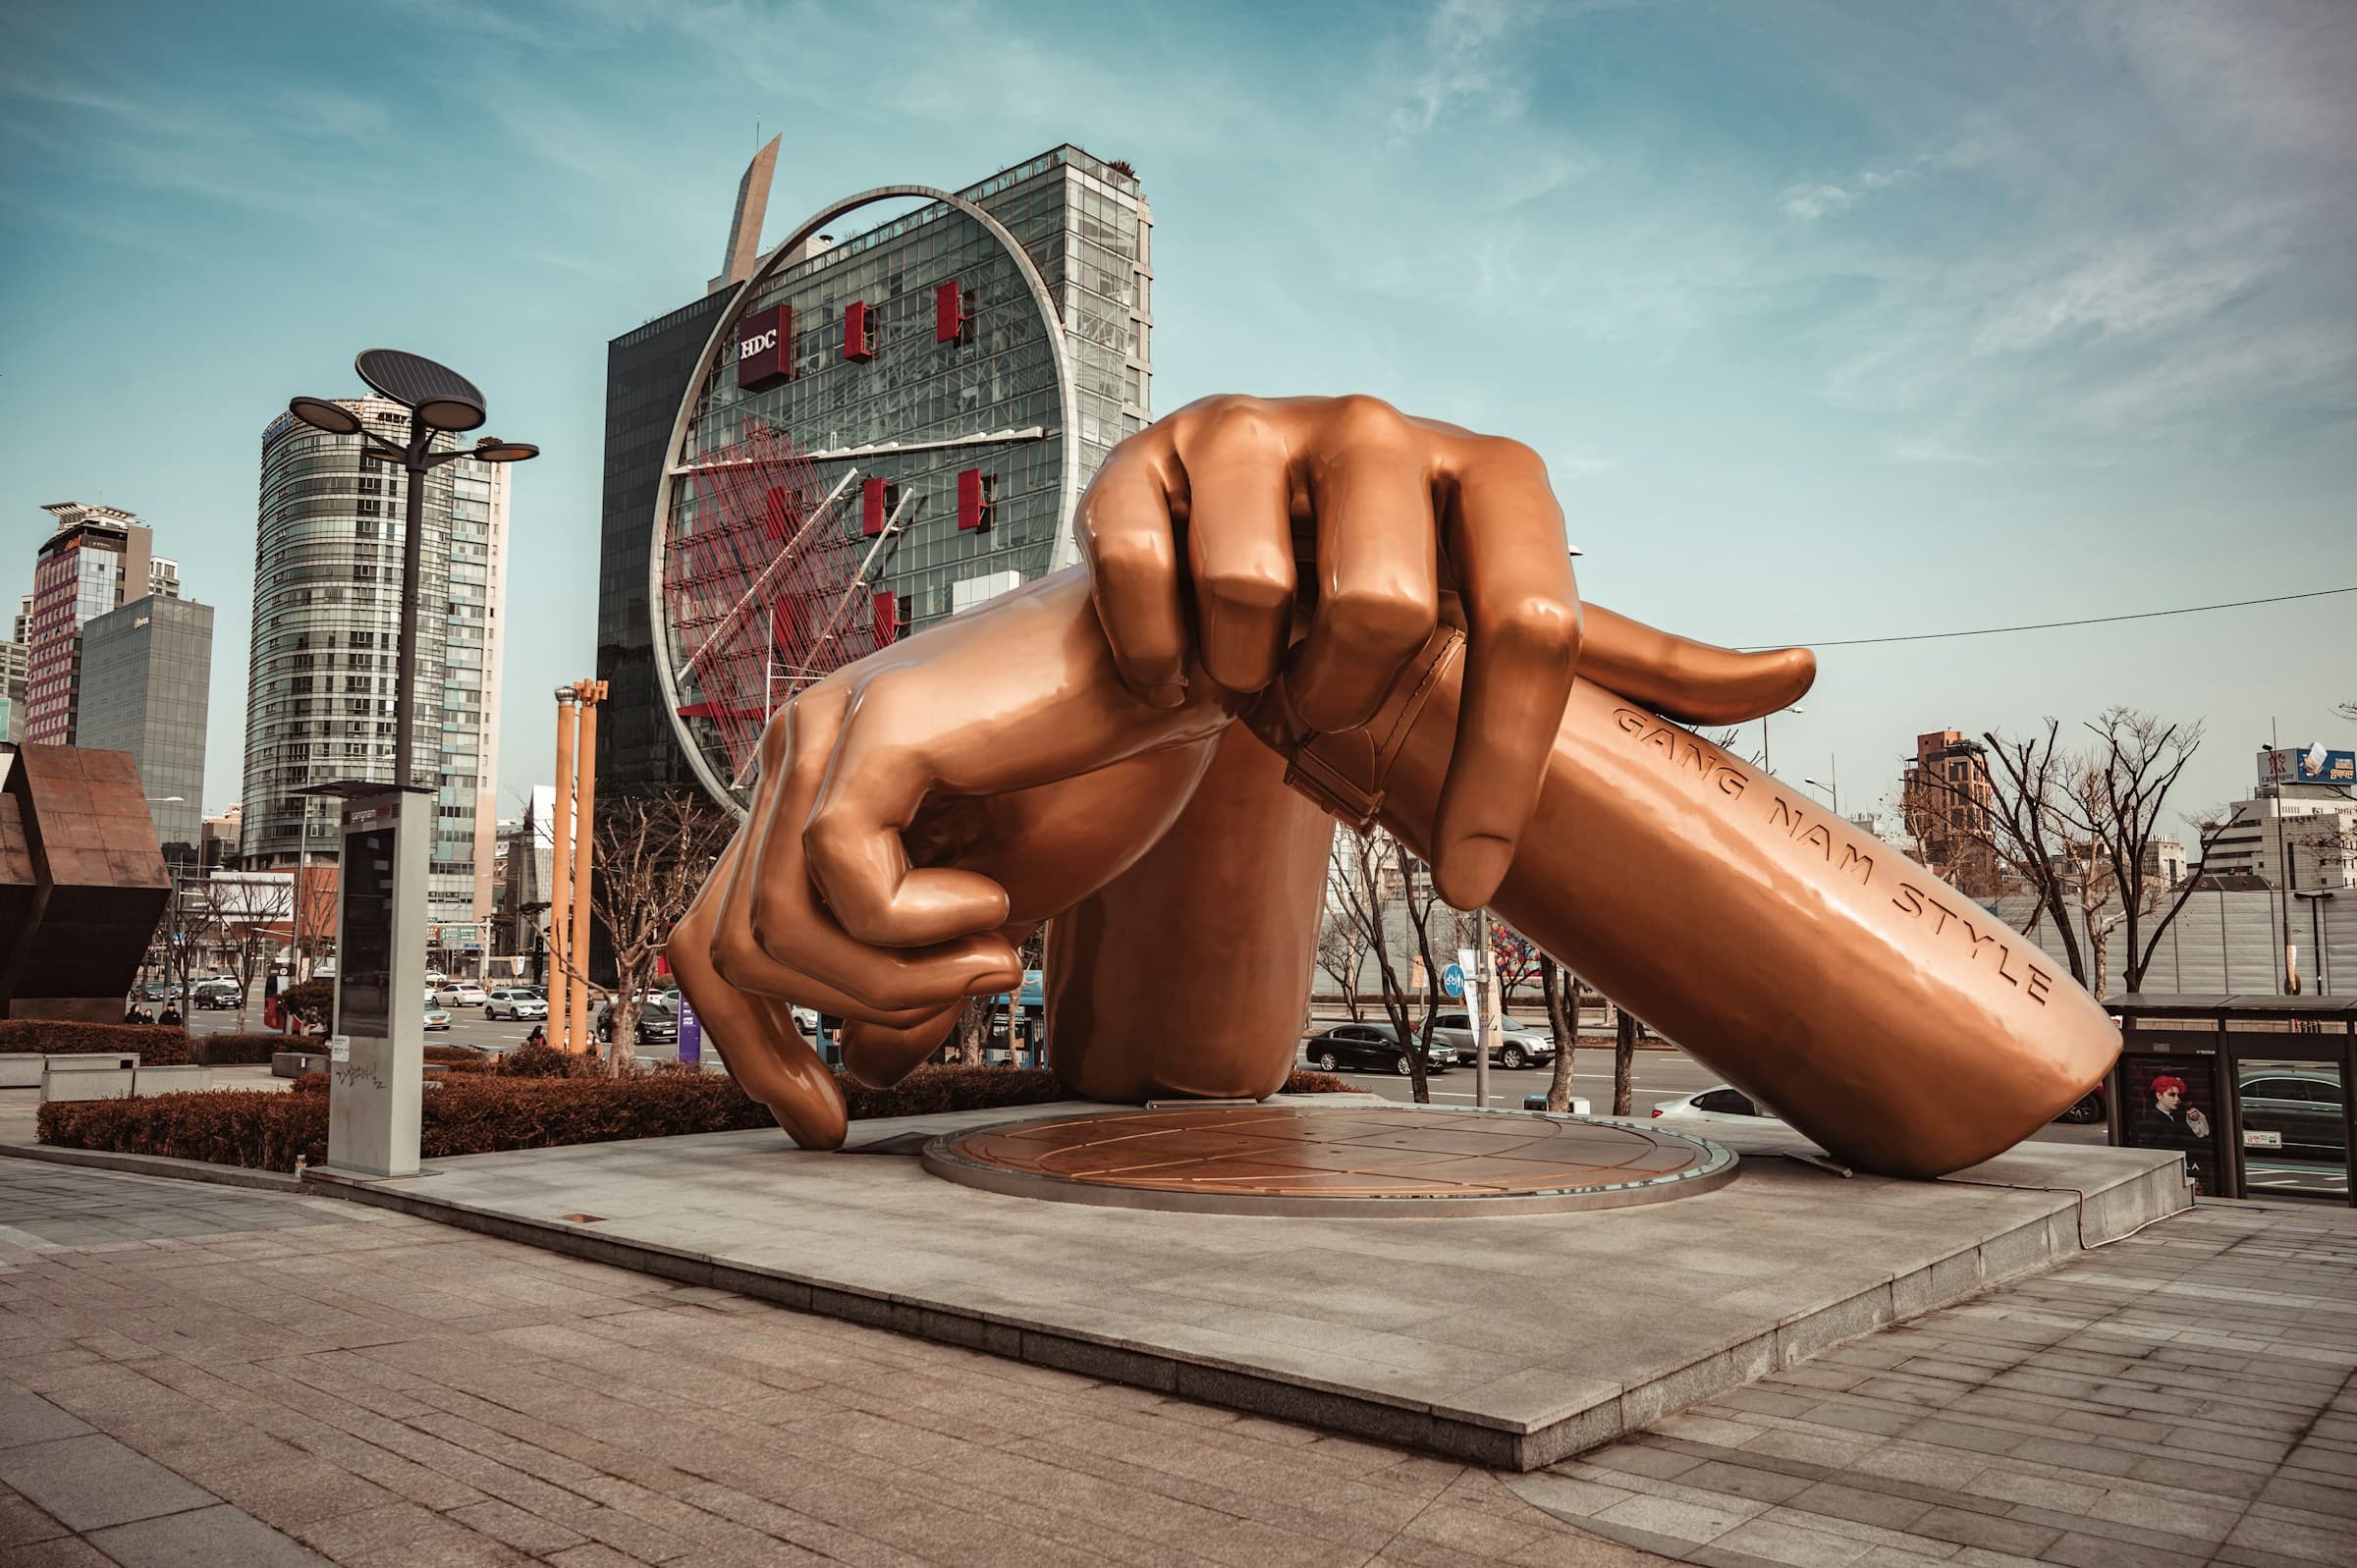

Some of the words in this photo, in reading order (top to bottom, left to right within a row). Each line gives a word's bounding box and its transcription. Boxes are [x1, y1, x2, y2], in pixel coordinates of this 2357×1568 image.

[740, 329, 777, 360] HDC
[1612, 708, 1749, 800] GANG
[1768, 796, 1873, 886] NAM
[1891, 883, 2053, 1006] STYLE
